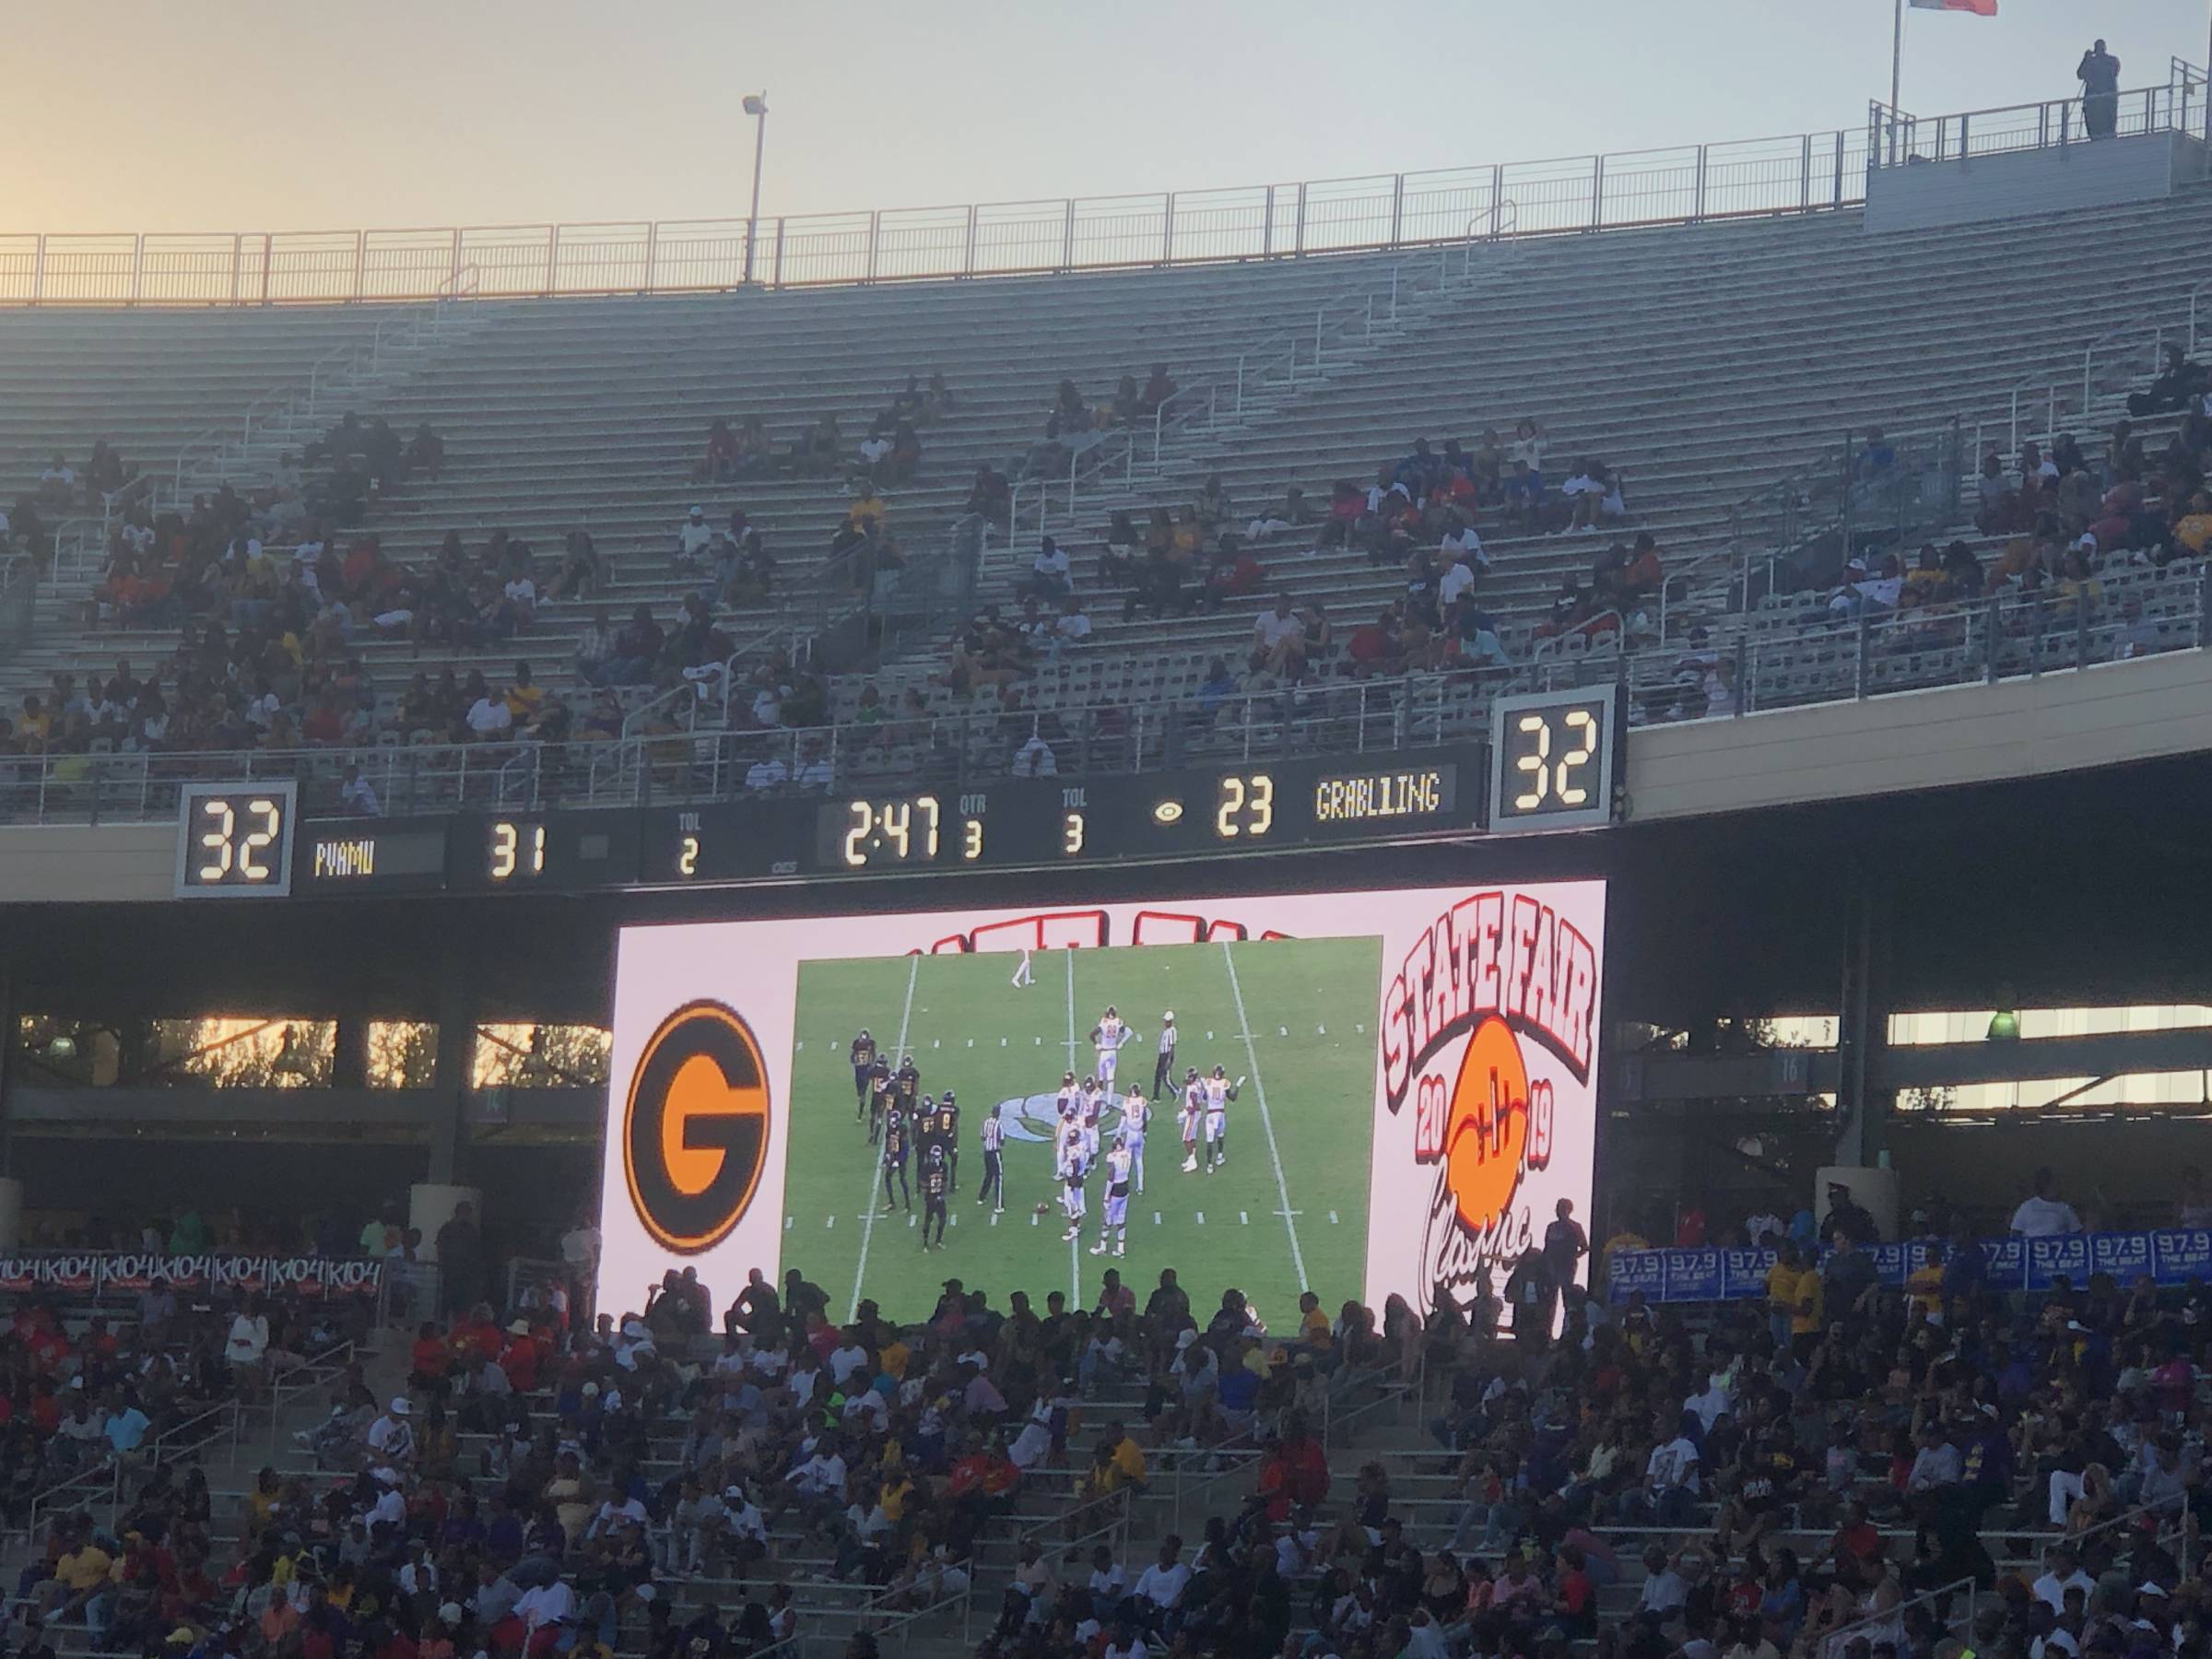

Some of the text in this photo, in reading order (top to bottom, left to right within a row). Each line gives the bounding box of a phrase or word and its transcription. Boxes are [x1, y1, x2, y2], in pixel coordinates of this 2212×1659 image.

[1514, 711, 1597, 809] 32
[1218, 775, 1274, 837] 23
[199, 800, 279, 880] 32
[845, 795, 939, 865] 2:47
[965, 820, 982, 859] 3
[1066, 814, 1083, 853] 3
[492, 822, 546, 877] 31
[680, 837, 699, 875] 2
[1382, 890, 1597, 1116] STATE FAIR
[628, 1008, 769, 1247] G
[1416, 1074, 1554, 1171] 20 19
[2034, 1240, 2085, 1258] 97.9
[2097, 1237, 2147, 1256] 97.9
[2158, 1232, 2210, 1253] 97.9
[45, 1255, 97, 1283] K104
[102, 1254, 153, 1282] K104
[159, 1254, 211, 1283] K104
[216, 1255, 267, 1285] K104
[272, 1257, 324, 1287] K104
[330, 1260, 382, 1288] K104
[1611, 1255, 1659, 1275] 97.9
[1671, 1253, 1716, 1271] 97.9
[1729, 1250, 1778, 1268] 97.9
